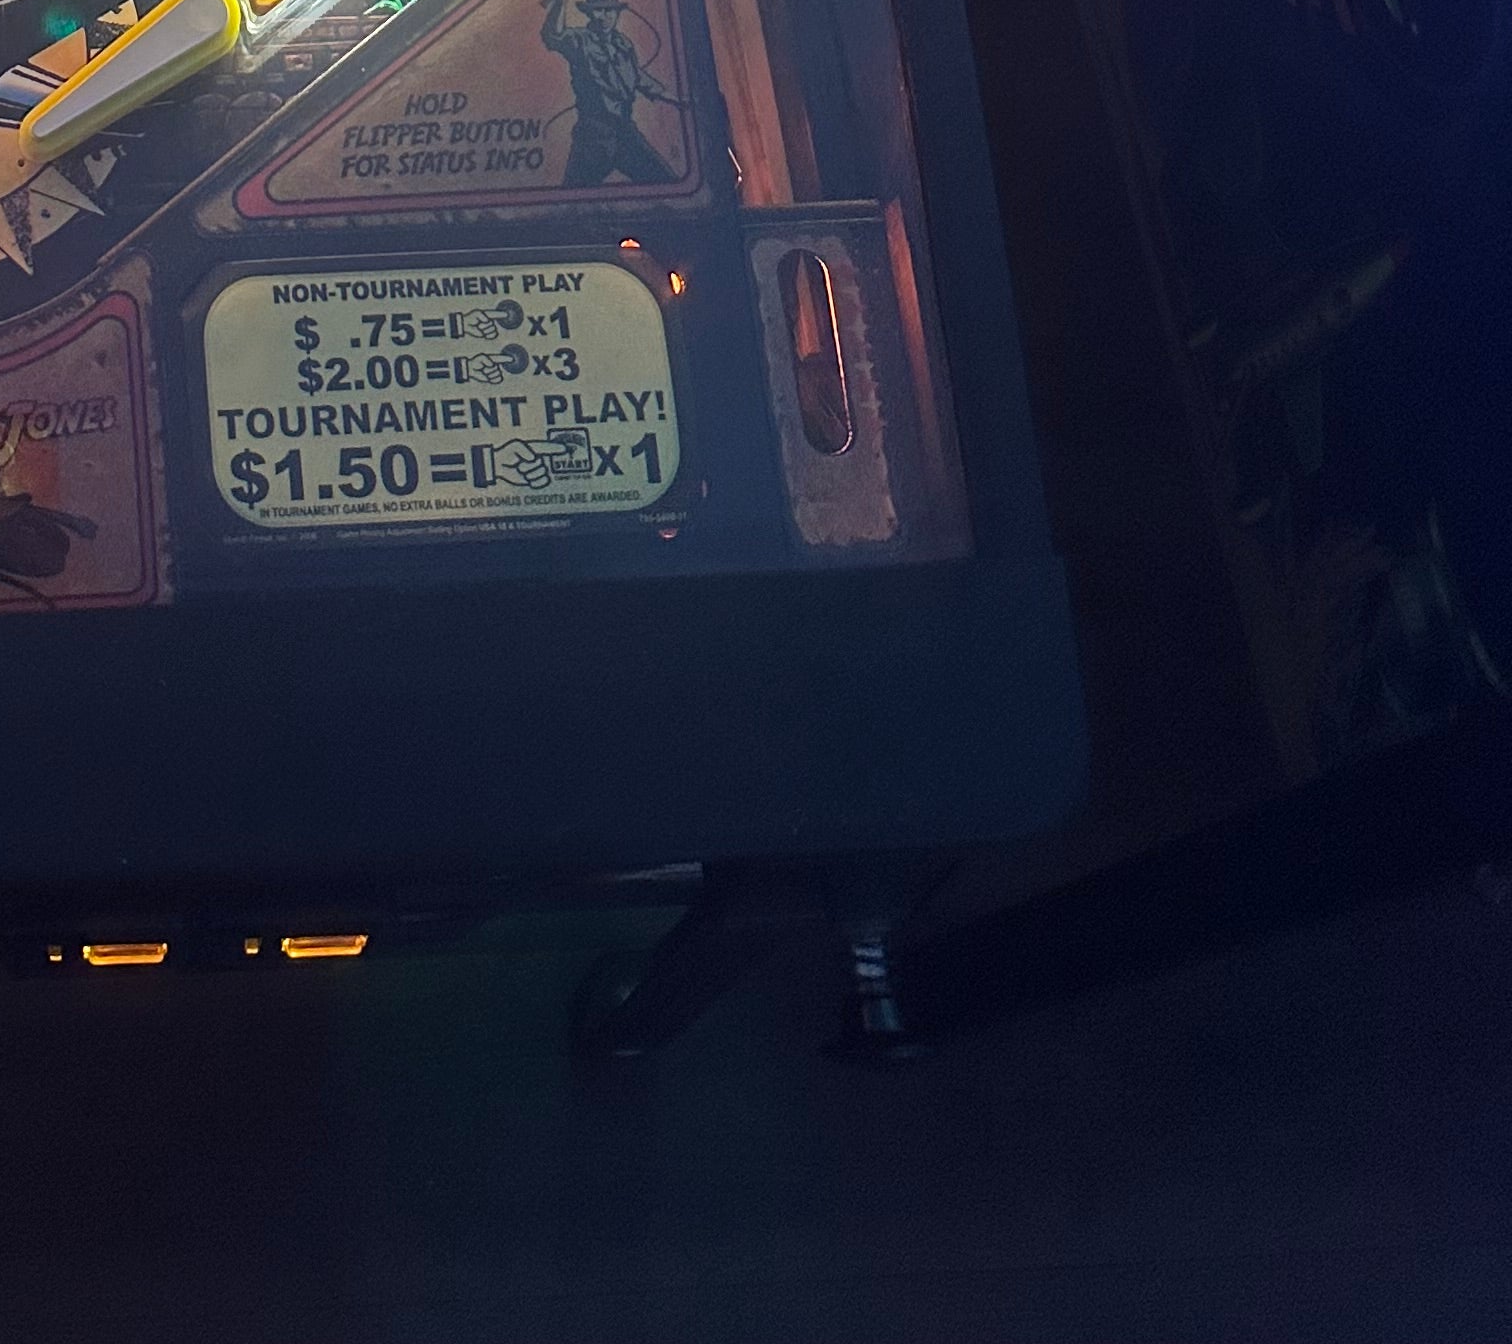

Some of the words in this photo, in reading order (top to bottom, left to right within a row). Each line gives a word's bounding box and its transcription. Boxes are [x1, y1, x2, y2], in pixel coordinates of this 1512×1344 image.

[403, 92, 468, 118] HOLD
[343, 121, 443, 148] FLIPPER
[447, 117, 542, 145] BUTTON
[340, 152, 392, 179] FOR
[396, 150, 479, 177] STATUS
[483, 146, 546, 174] INFO
[272, 275, 515, 305] NON-TOURNAMENT
[522, 272, 585, 294] PLAY
[294, 315, 322, 354] $
[217, 395, 529, 440] TOURNAMENT
[544, 390, 668, 426] PLAY!
[272, 503, 341, 517] TOURNAMENT
[400, 500, 434, 511] EXTRA
[435, 497, 468, 509] BALLS
[469, 497, 486, 508] OR
[487, 496, 522, 507] BONUS
[523, 493, 566, 505] CREDITS
[567, 492, 588, 503] ARE
